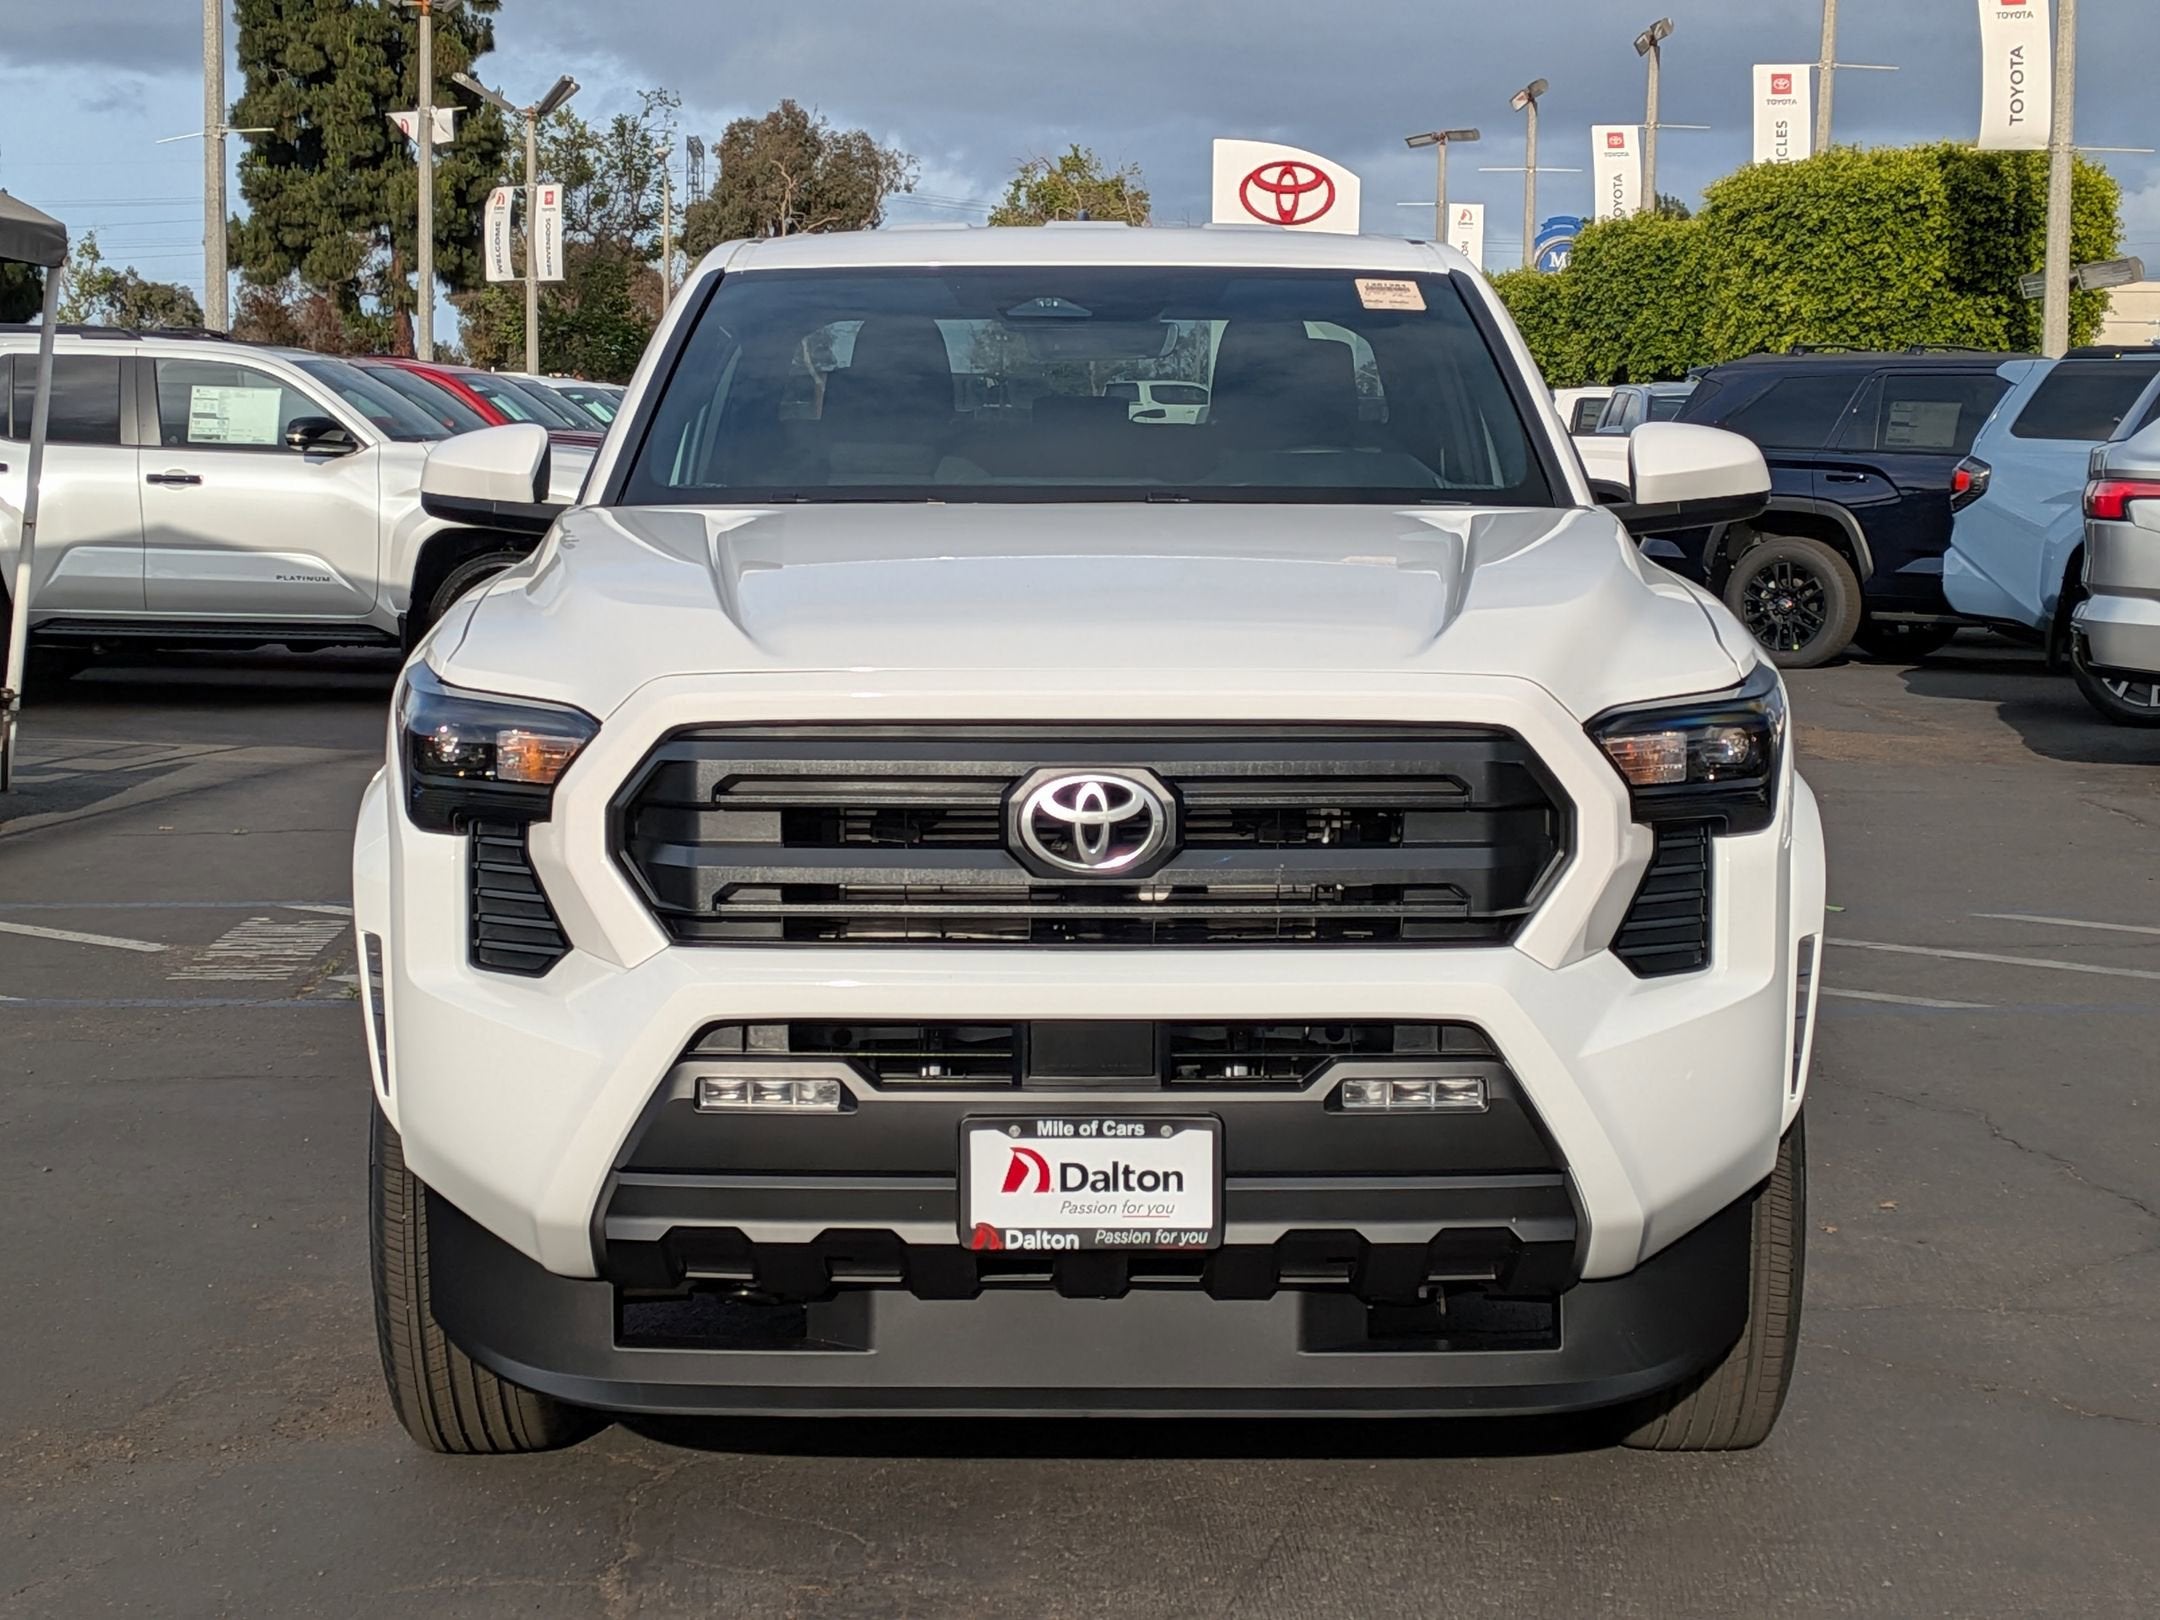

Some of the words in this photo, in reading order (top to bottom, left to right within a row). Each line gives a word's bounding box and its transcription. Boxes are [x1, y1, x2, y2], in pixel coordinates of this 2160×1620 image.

[1996, 11, 2034, 19] TOYOTA
[2009, 45, 2024, 126] TOYOTA
[1766, 98, 1798, 106] TOYOTA
[1775, 120, 1789, 162] ICLES
[1612, 173, 1624, 218] OYOTA
[494, 221, 504, 274] WELCOME
[276, 574, 331, 582] PLATINUM
[1036, 1120, 1075, 1136] Mile
[1079, 1120, 1099, 1136] of
[1102, 1120, 1146, 1136] Cars
[1060, 1161, 1184, 1193] Dalton
[1060, 1200, 1118, 1215] Passion
[1121, 1200, 1145, 1215] for
[1146, 1203, 1176, 1217] you
[1005, 1229, 1080, 1250] Dalton
[1095, 1229, 1151, 1245] Passion
[1153, 1229, 1178, 1245] for
[1178, 1231, 1209, 1247] you
